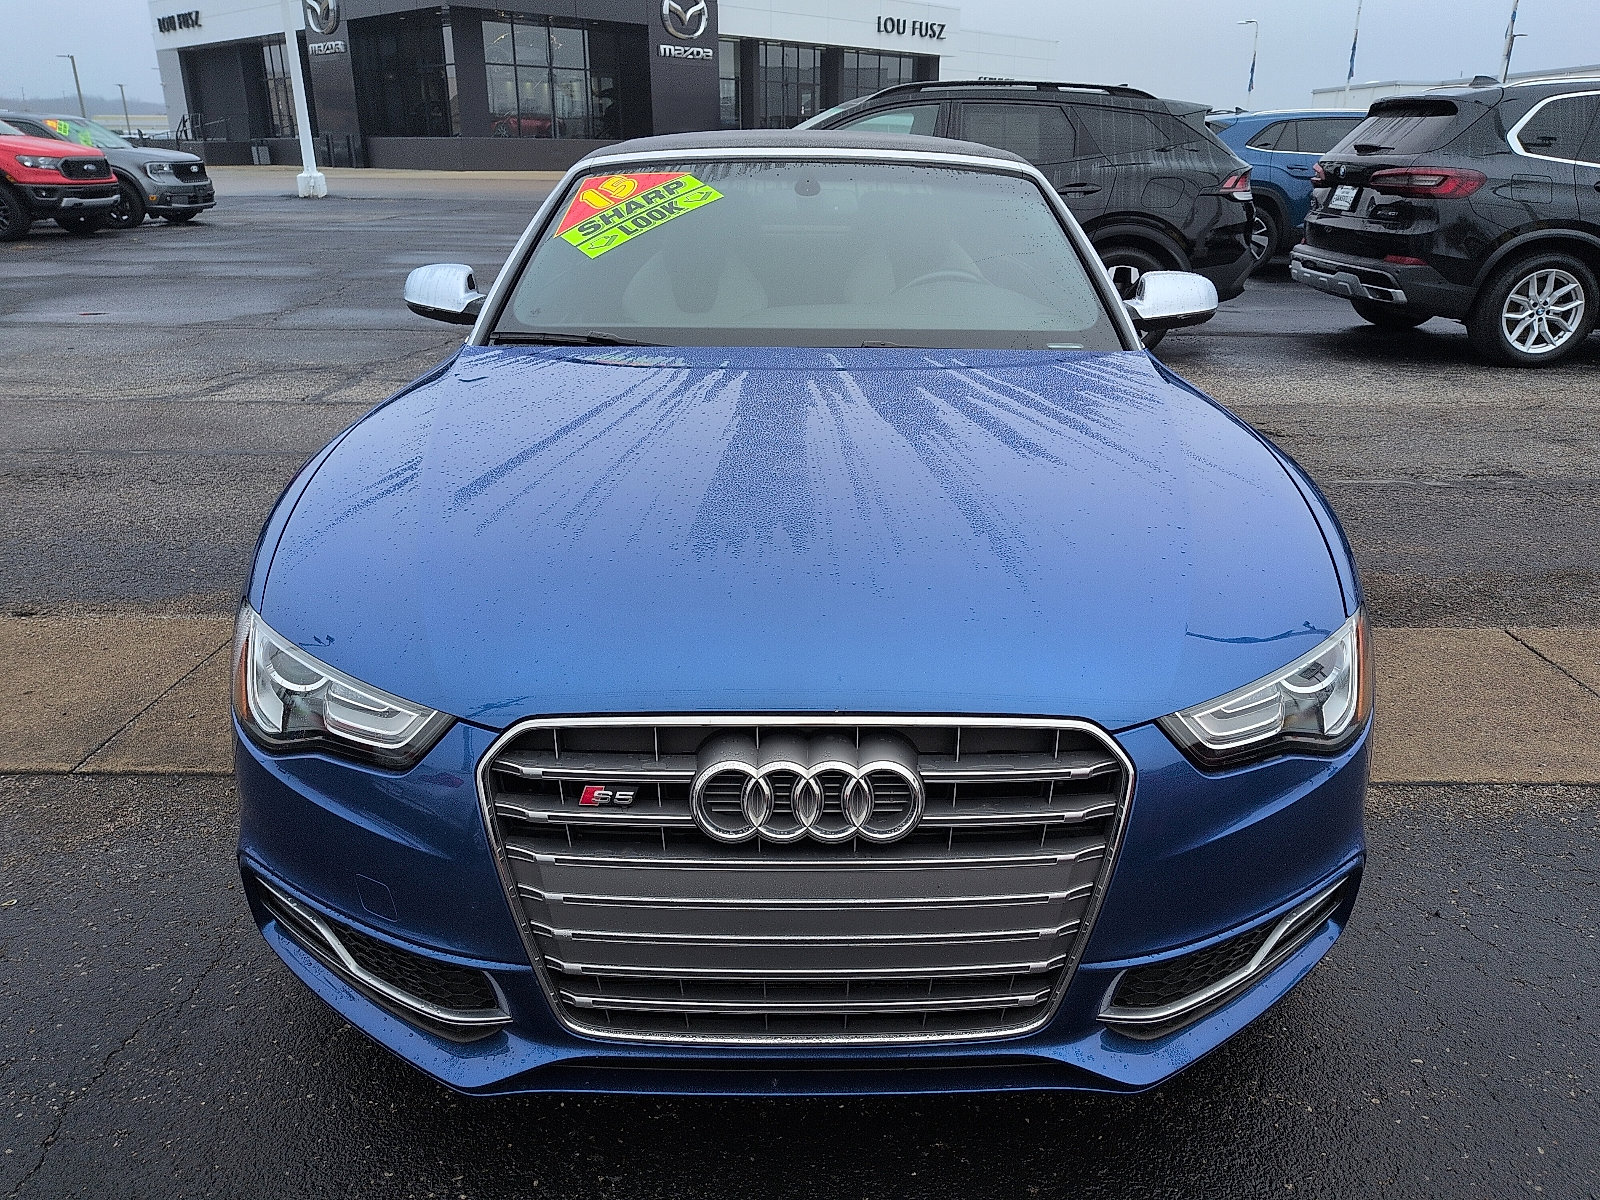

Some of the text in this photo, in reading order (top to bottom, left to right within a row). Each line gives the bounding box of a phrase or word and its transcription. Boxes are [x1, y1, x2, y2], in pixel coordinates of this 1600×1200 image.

[877, 16, 946, 39] LOU FUSZ
[578, 180, 686, 237] SHARP
[580, 175, 638, 209] 15
[617, 200, 685, 235] LOOK
[591, 789, 635, 805] S5
